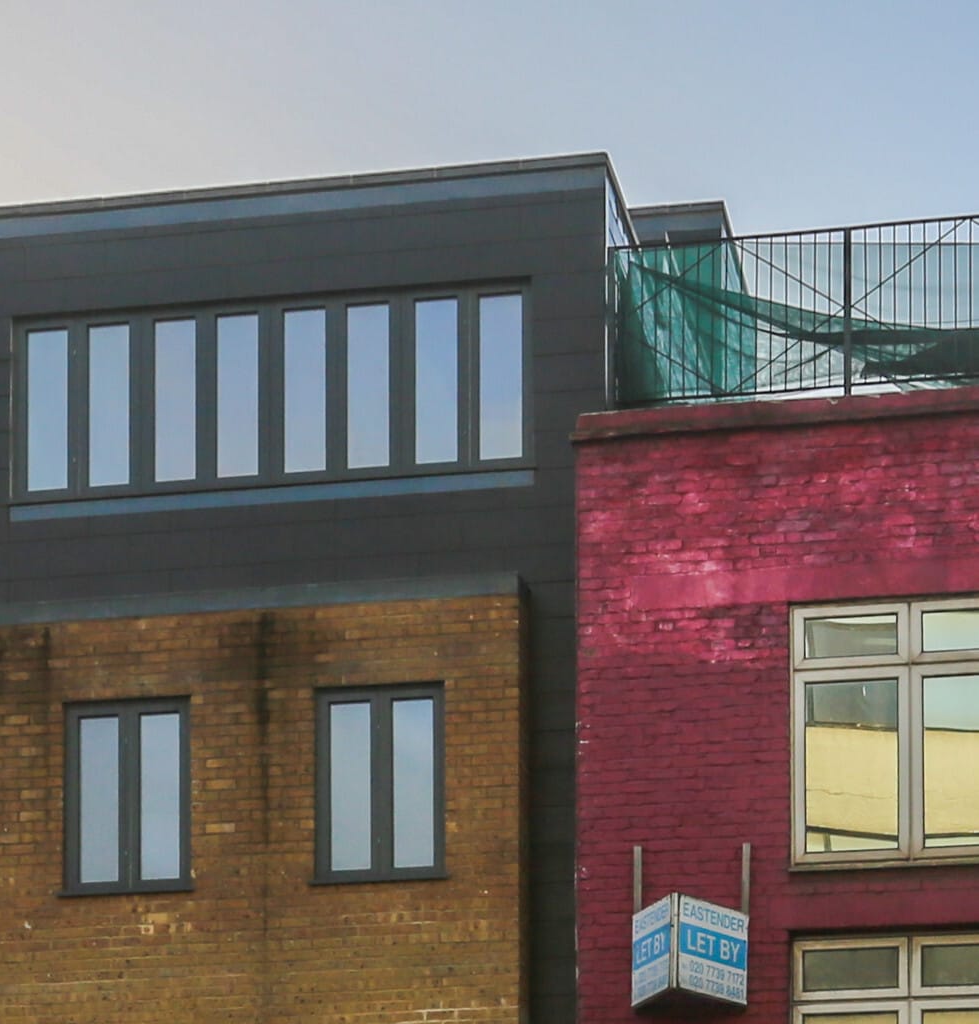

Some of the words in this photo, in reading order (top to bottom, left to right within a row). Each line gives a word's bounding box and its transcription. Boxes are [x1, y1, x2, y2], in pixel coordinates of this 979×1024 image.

[683, 902, 744, 933] EASTENDER
[636, 939, 652, 964] LET
[687, 929, 716, 956] LET
[720, 940, 741, 963] BY
